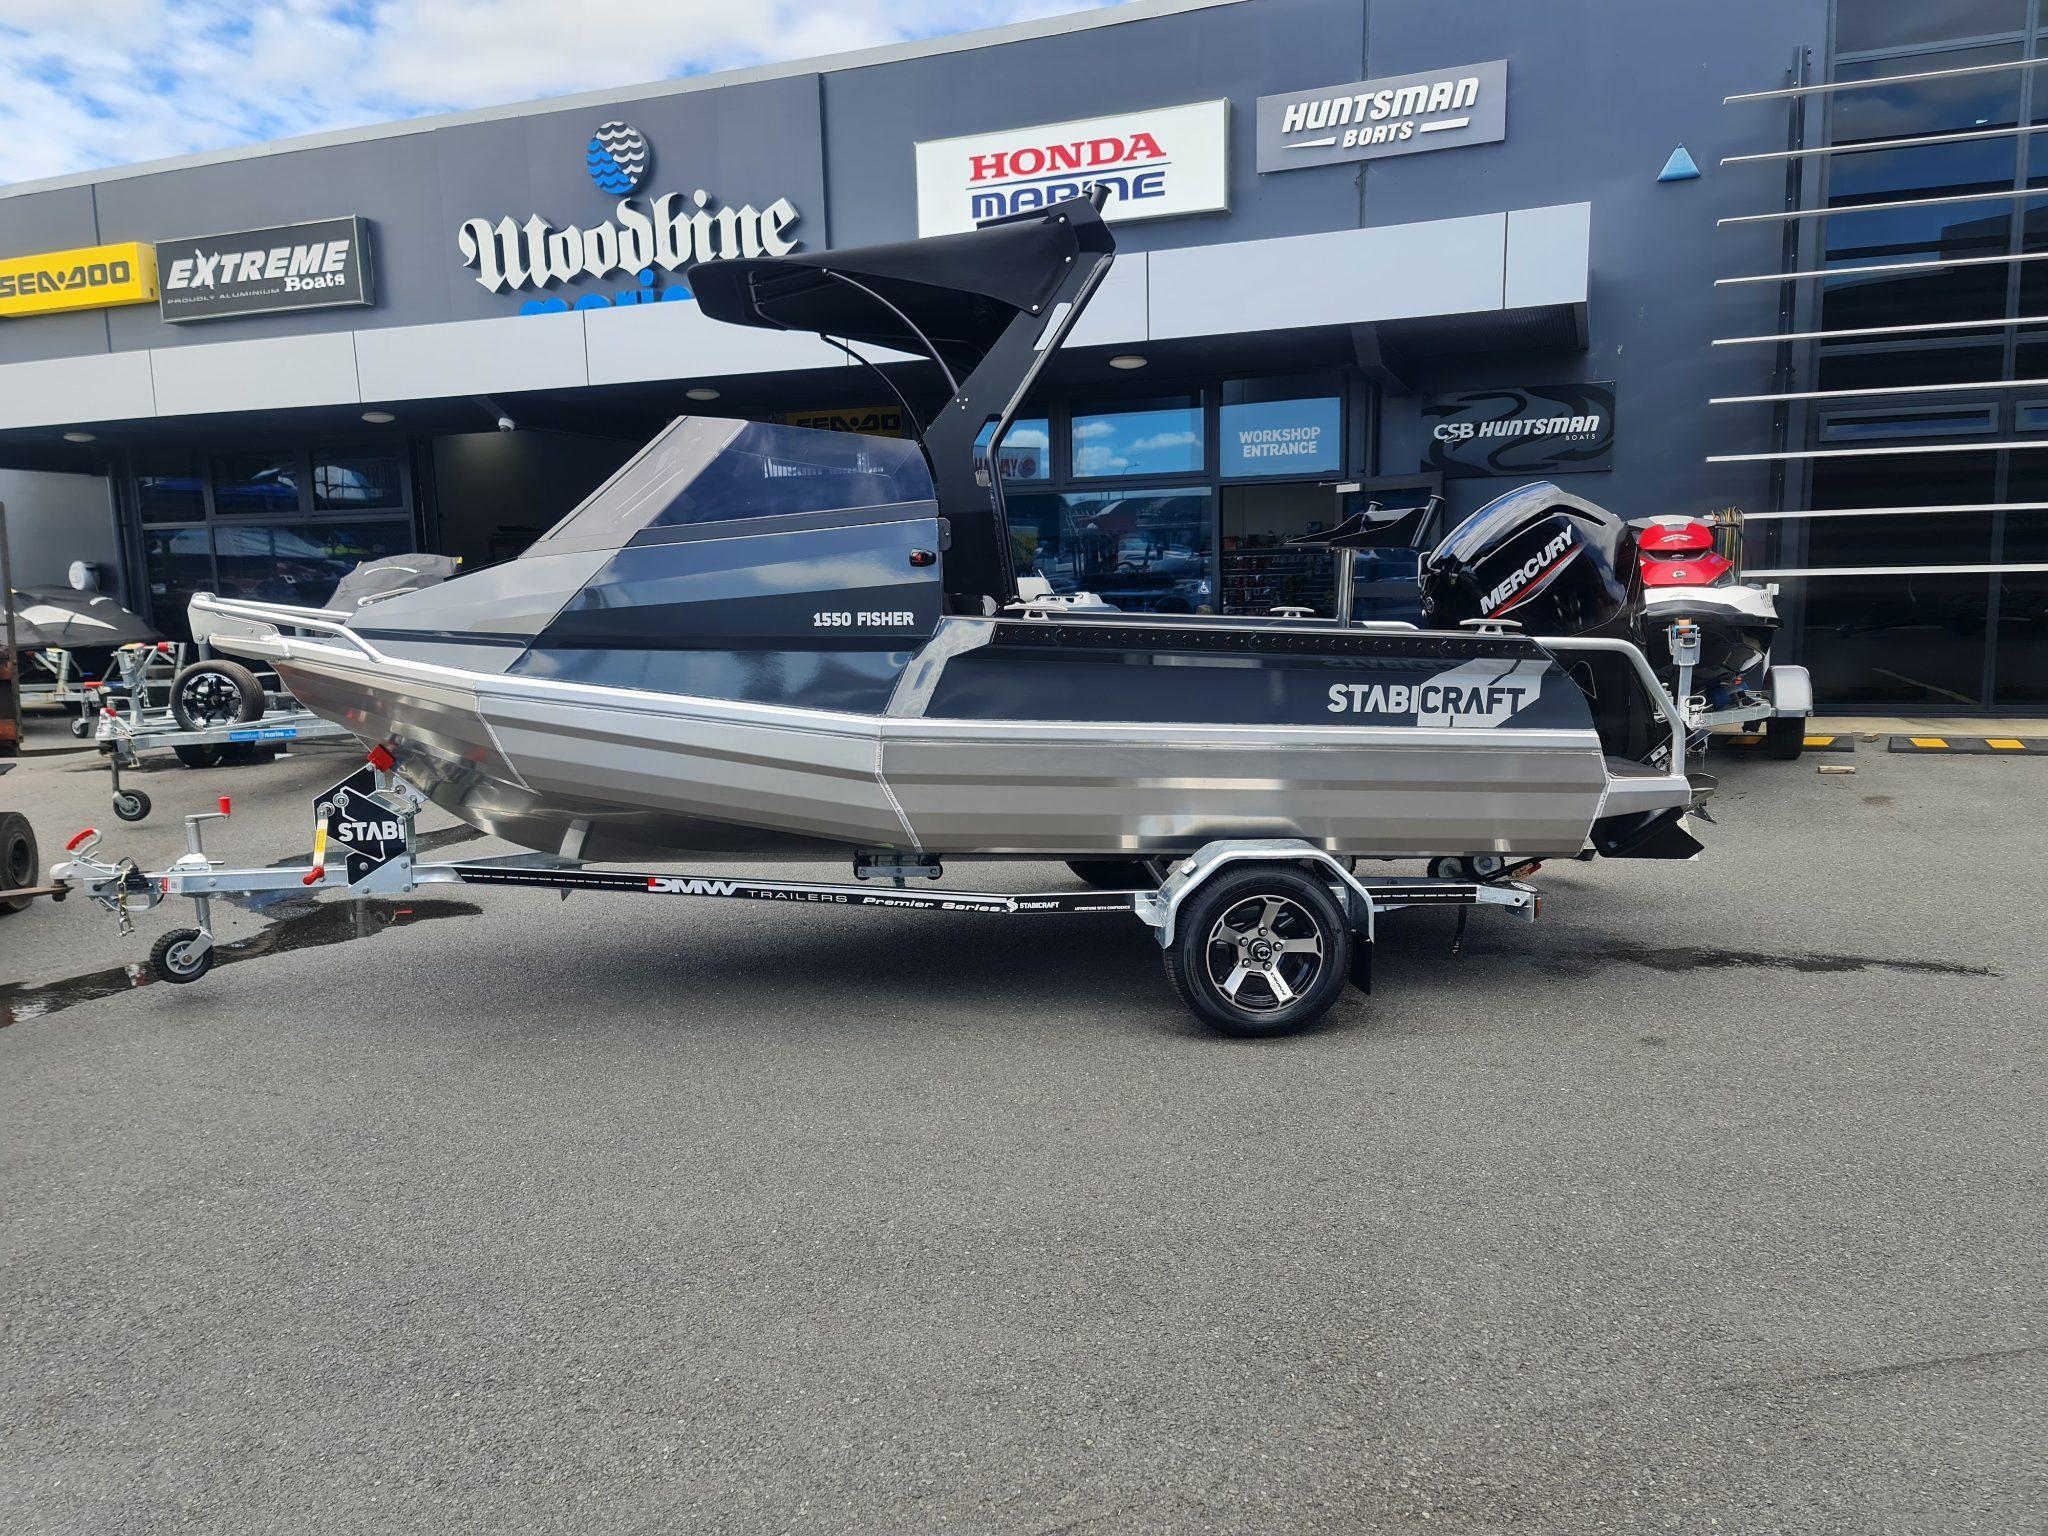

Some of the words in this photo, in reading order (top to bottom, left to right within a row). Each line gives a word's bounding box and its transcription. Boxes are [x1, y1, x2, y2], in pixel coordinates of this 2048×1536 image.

[1282, 77, 1479, 133] HUNTSMAN
[1342, 120, 1414, 148] BOATS
[969, 132, 1167, 182] HONDA
[458, 189, 799, 293] Woodbine
[166, 239, 350, 290] EXTREME
[219, 287, 281, 300] ALUMINIUM
[283, 272, 346, 293] Boats
[1239, 426, 1321, 444] WORKSHOP
[1433, 421, 1475, 444] CSB
[1478, 415, 1600, 438] HUNTSMAN
[1565, 433, 1597, 441] BOATS
[1243, 441, 1317, 458] ENTRANCE
[1480, 523, 1573, 615] MERCURY
[813, 611, 852, 627] 1550
[857, 611, 915, 626] FISHER
[1327, 683, 1526, 715] STABICRAFT
[338, 820, 406, 842] STABI
[647, 877, 739, 896] DMW
[747, 890, 848, 903] TRAILERS
[863, 897, 934, 908] Premier
[942, 902, 1001, 913] Series
[1019, 901, 1059, 909] STABICRAFT
